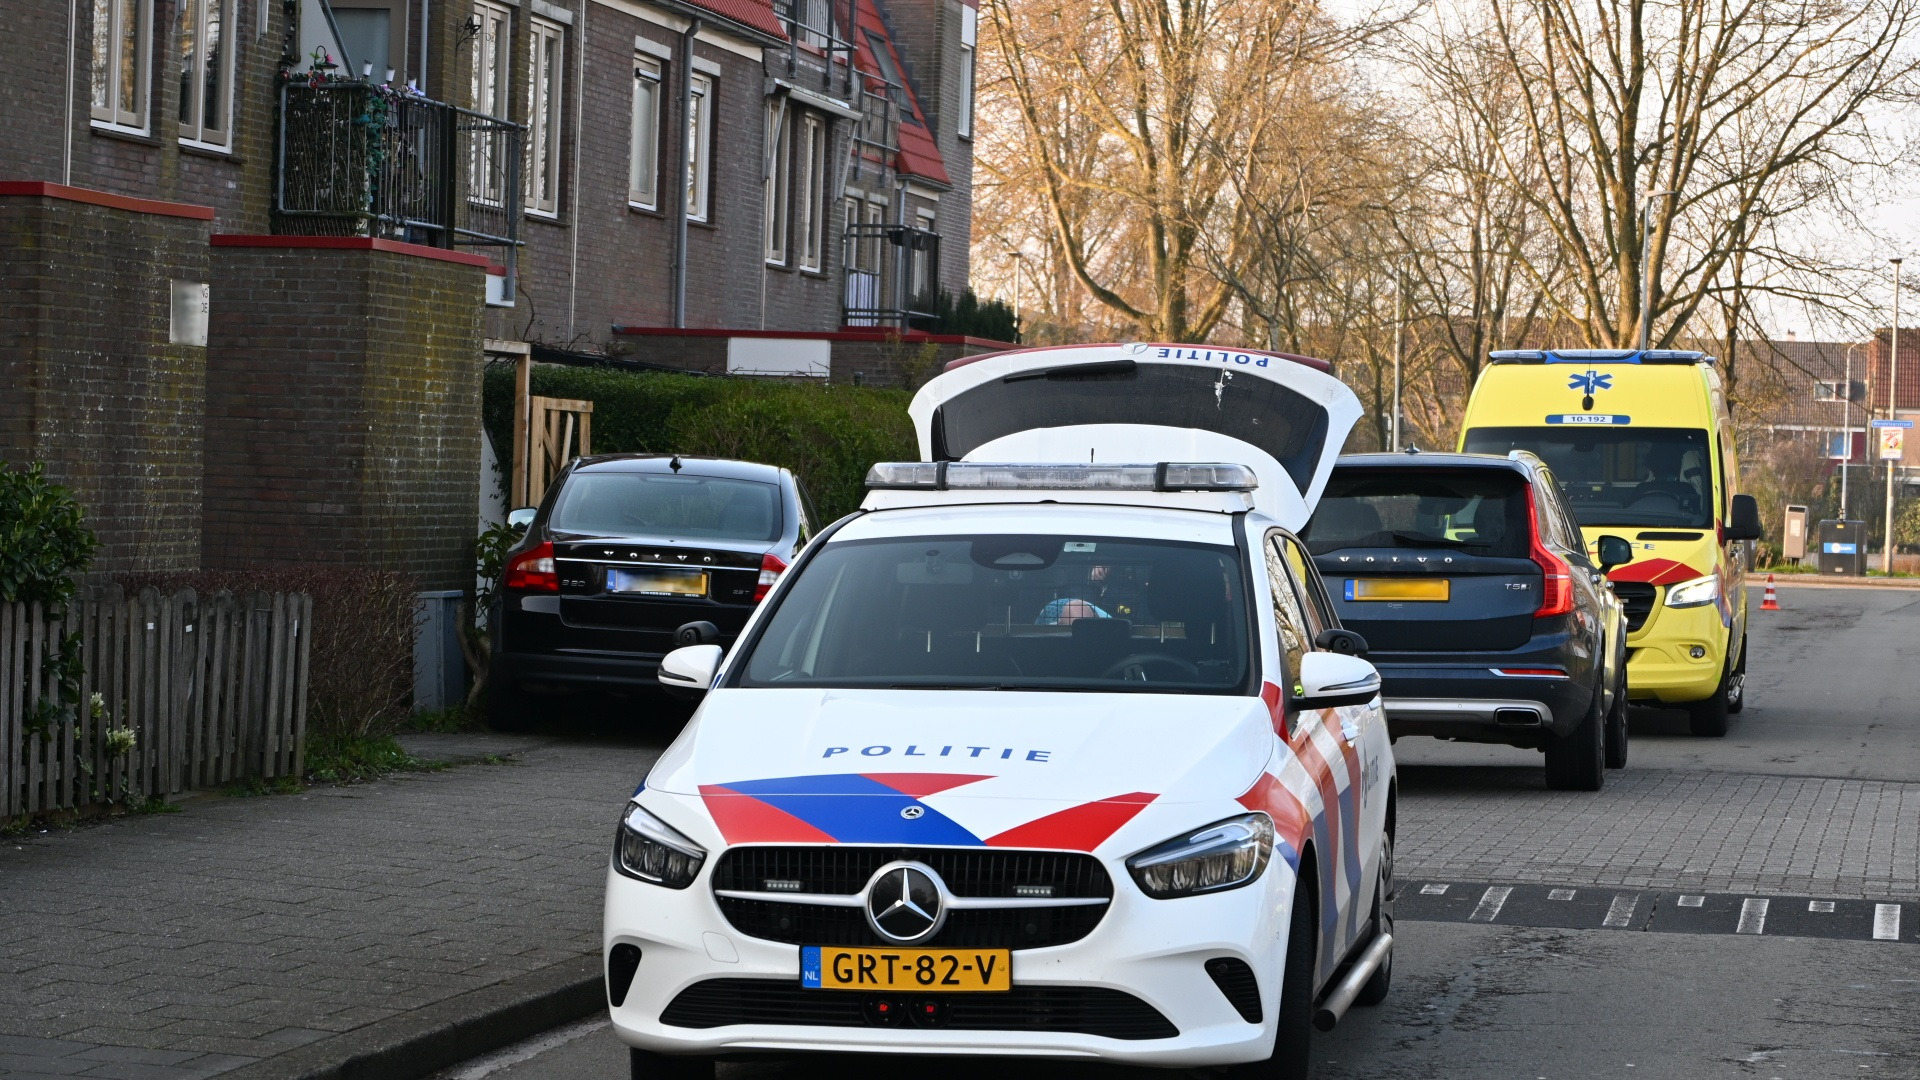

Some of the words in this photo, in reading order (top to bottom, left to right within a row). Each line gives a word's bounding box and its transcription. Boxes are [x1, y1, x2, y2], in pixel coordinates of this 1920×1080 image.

[1157, 348, 1269, 368] POLITIE
[603, 550, 711, 562] VOLVO
[1339, 556, 1453, 564] VOLVO
[821, 745, 1052, 763] POLITIE
[804, 971, 819, 982] NL
[832, 952, 997, 986] GRT-82-V
